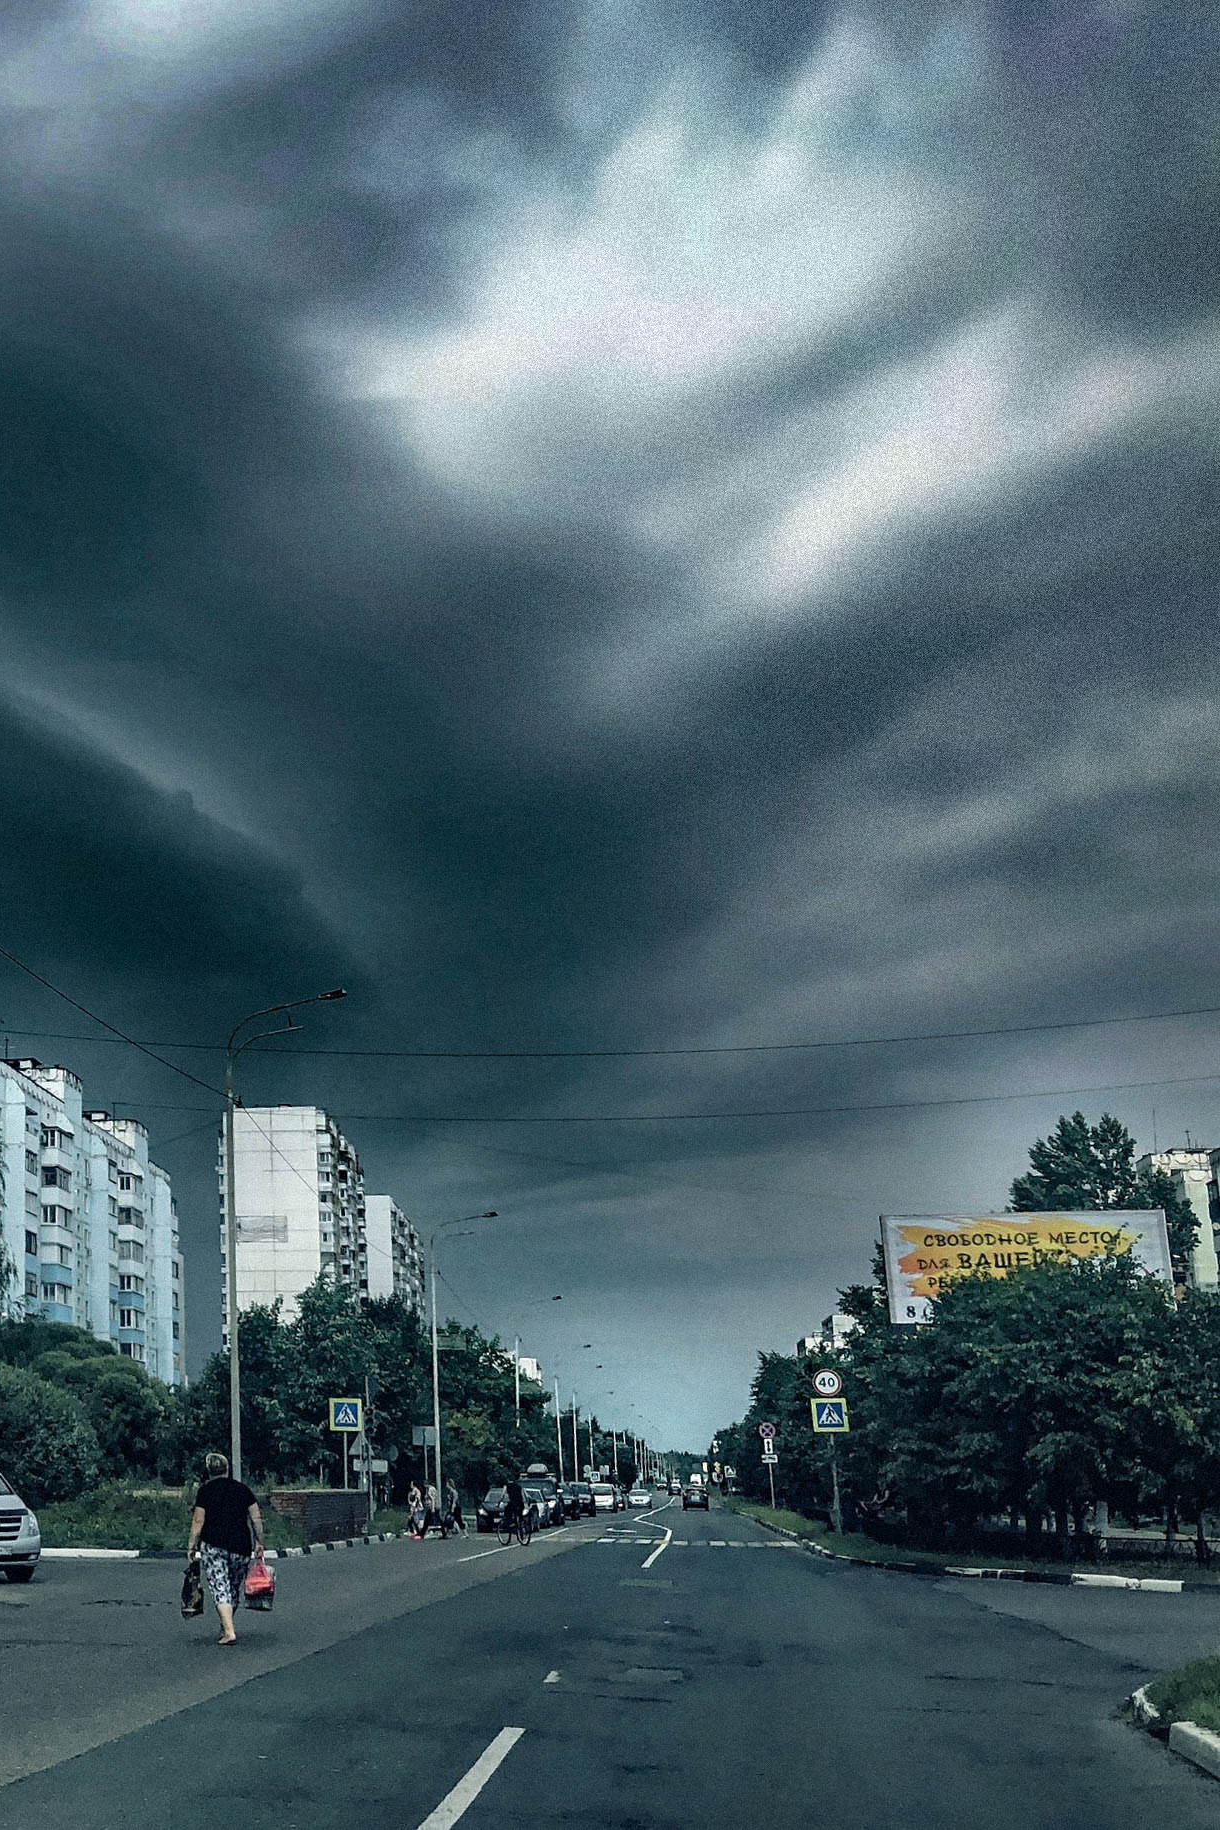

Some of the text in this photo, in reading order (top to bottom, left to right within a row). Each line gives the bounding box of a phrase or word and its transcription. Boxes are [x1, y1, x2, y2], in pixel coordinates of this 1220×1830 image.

[923, 1231, 1114, 1248] СВОБОДНОЕ МЕСТО
[917, 1258, 950, 1270] ДЛЯ
[906, 1305, 917, 1319] 8
[818, 1377, 836, 1388] 40
